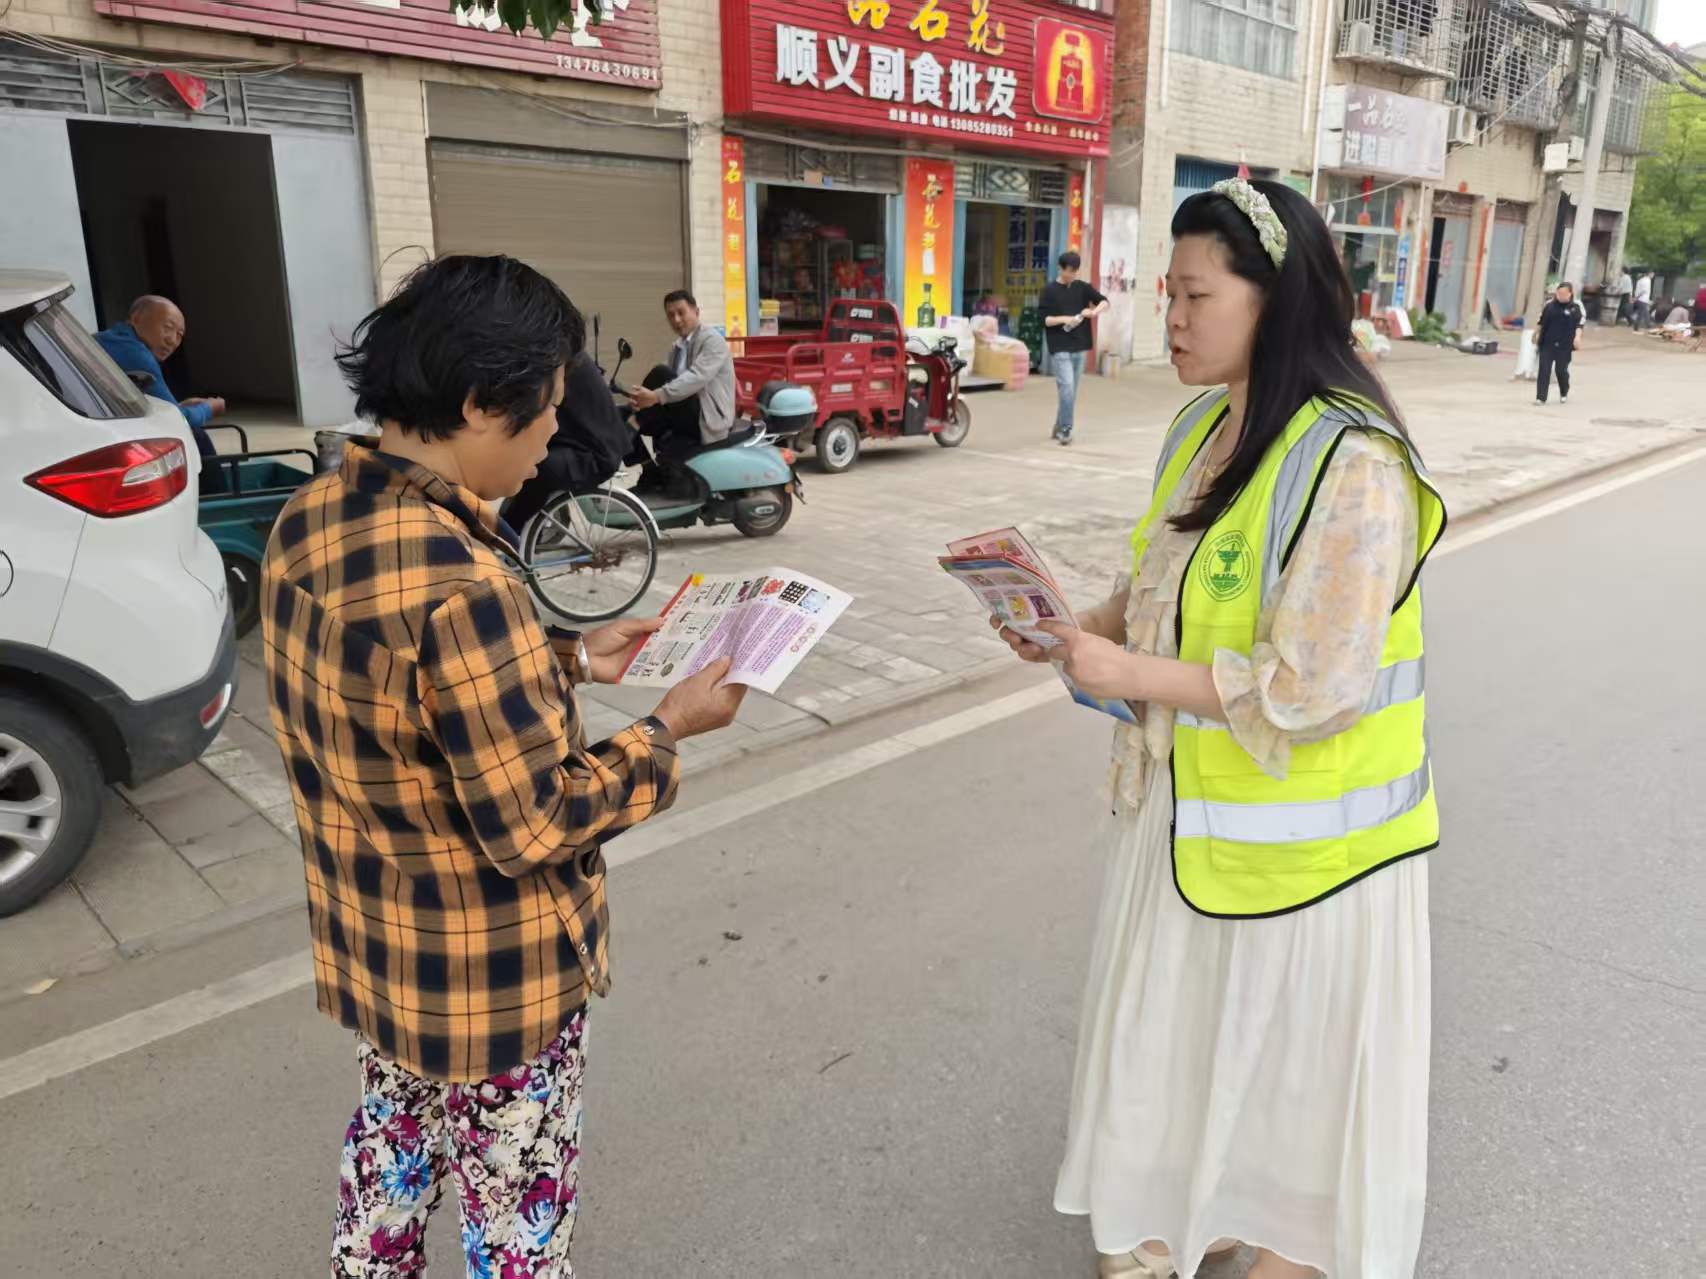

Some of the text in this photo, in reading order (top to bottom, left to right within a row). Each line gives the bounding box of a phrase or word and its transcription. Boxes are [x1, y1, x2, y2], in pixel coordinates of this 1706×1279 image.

[776, 23, 1017, 119] 顺义副食批发
